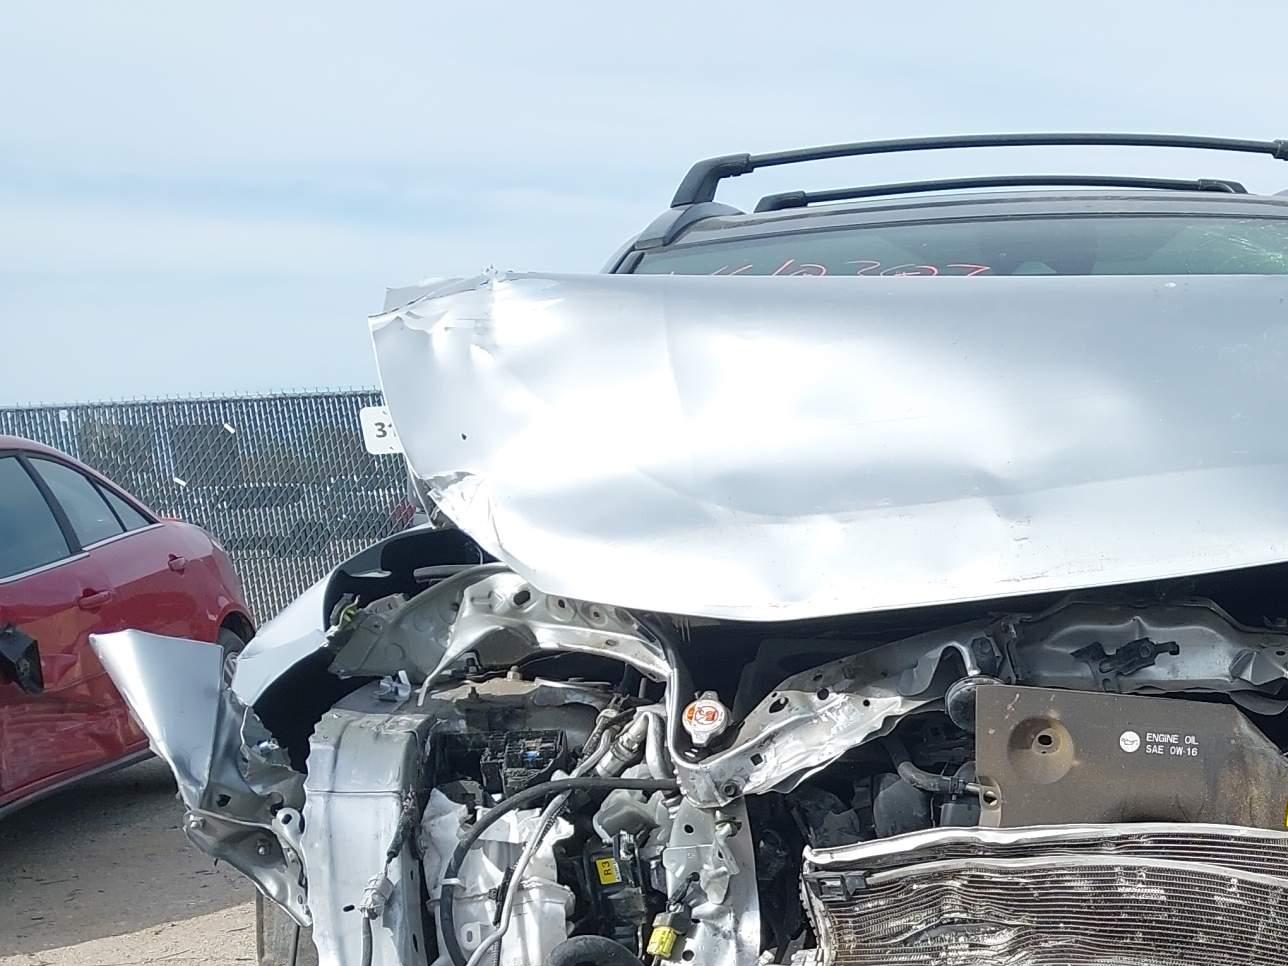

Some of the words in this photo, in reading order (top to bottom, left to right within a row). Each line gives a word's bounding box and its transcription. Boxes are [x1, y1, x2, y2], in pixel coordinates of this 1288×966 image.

[1146, 732, 1180, 744] ENGINE
[1184, 735, 1199, 745] OIL
[1145, 744, 1165, 754] SAE
[1169, 746, 1198, 757] 0W-16
